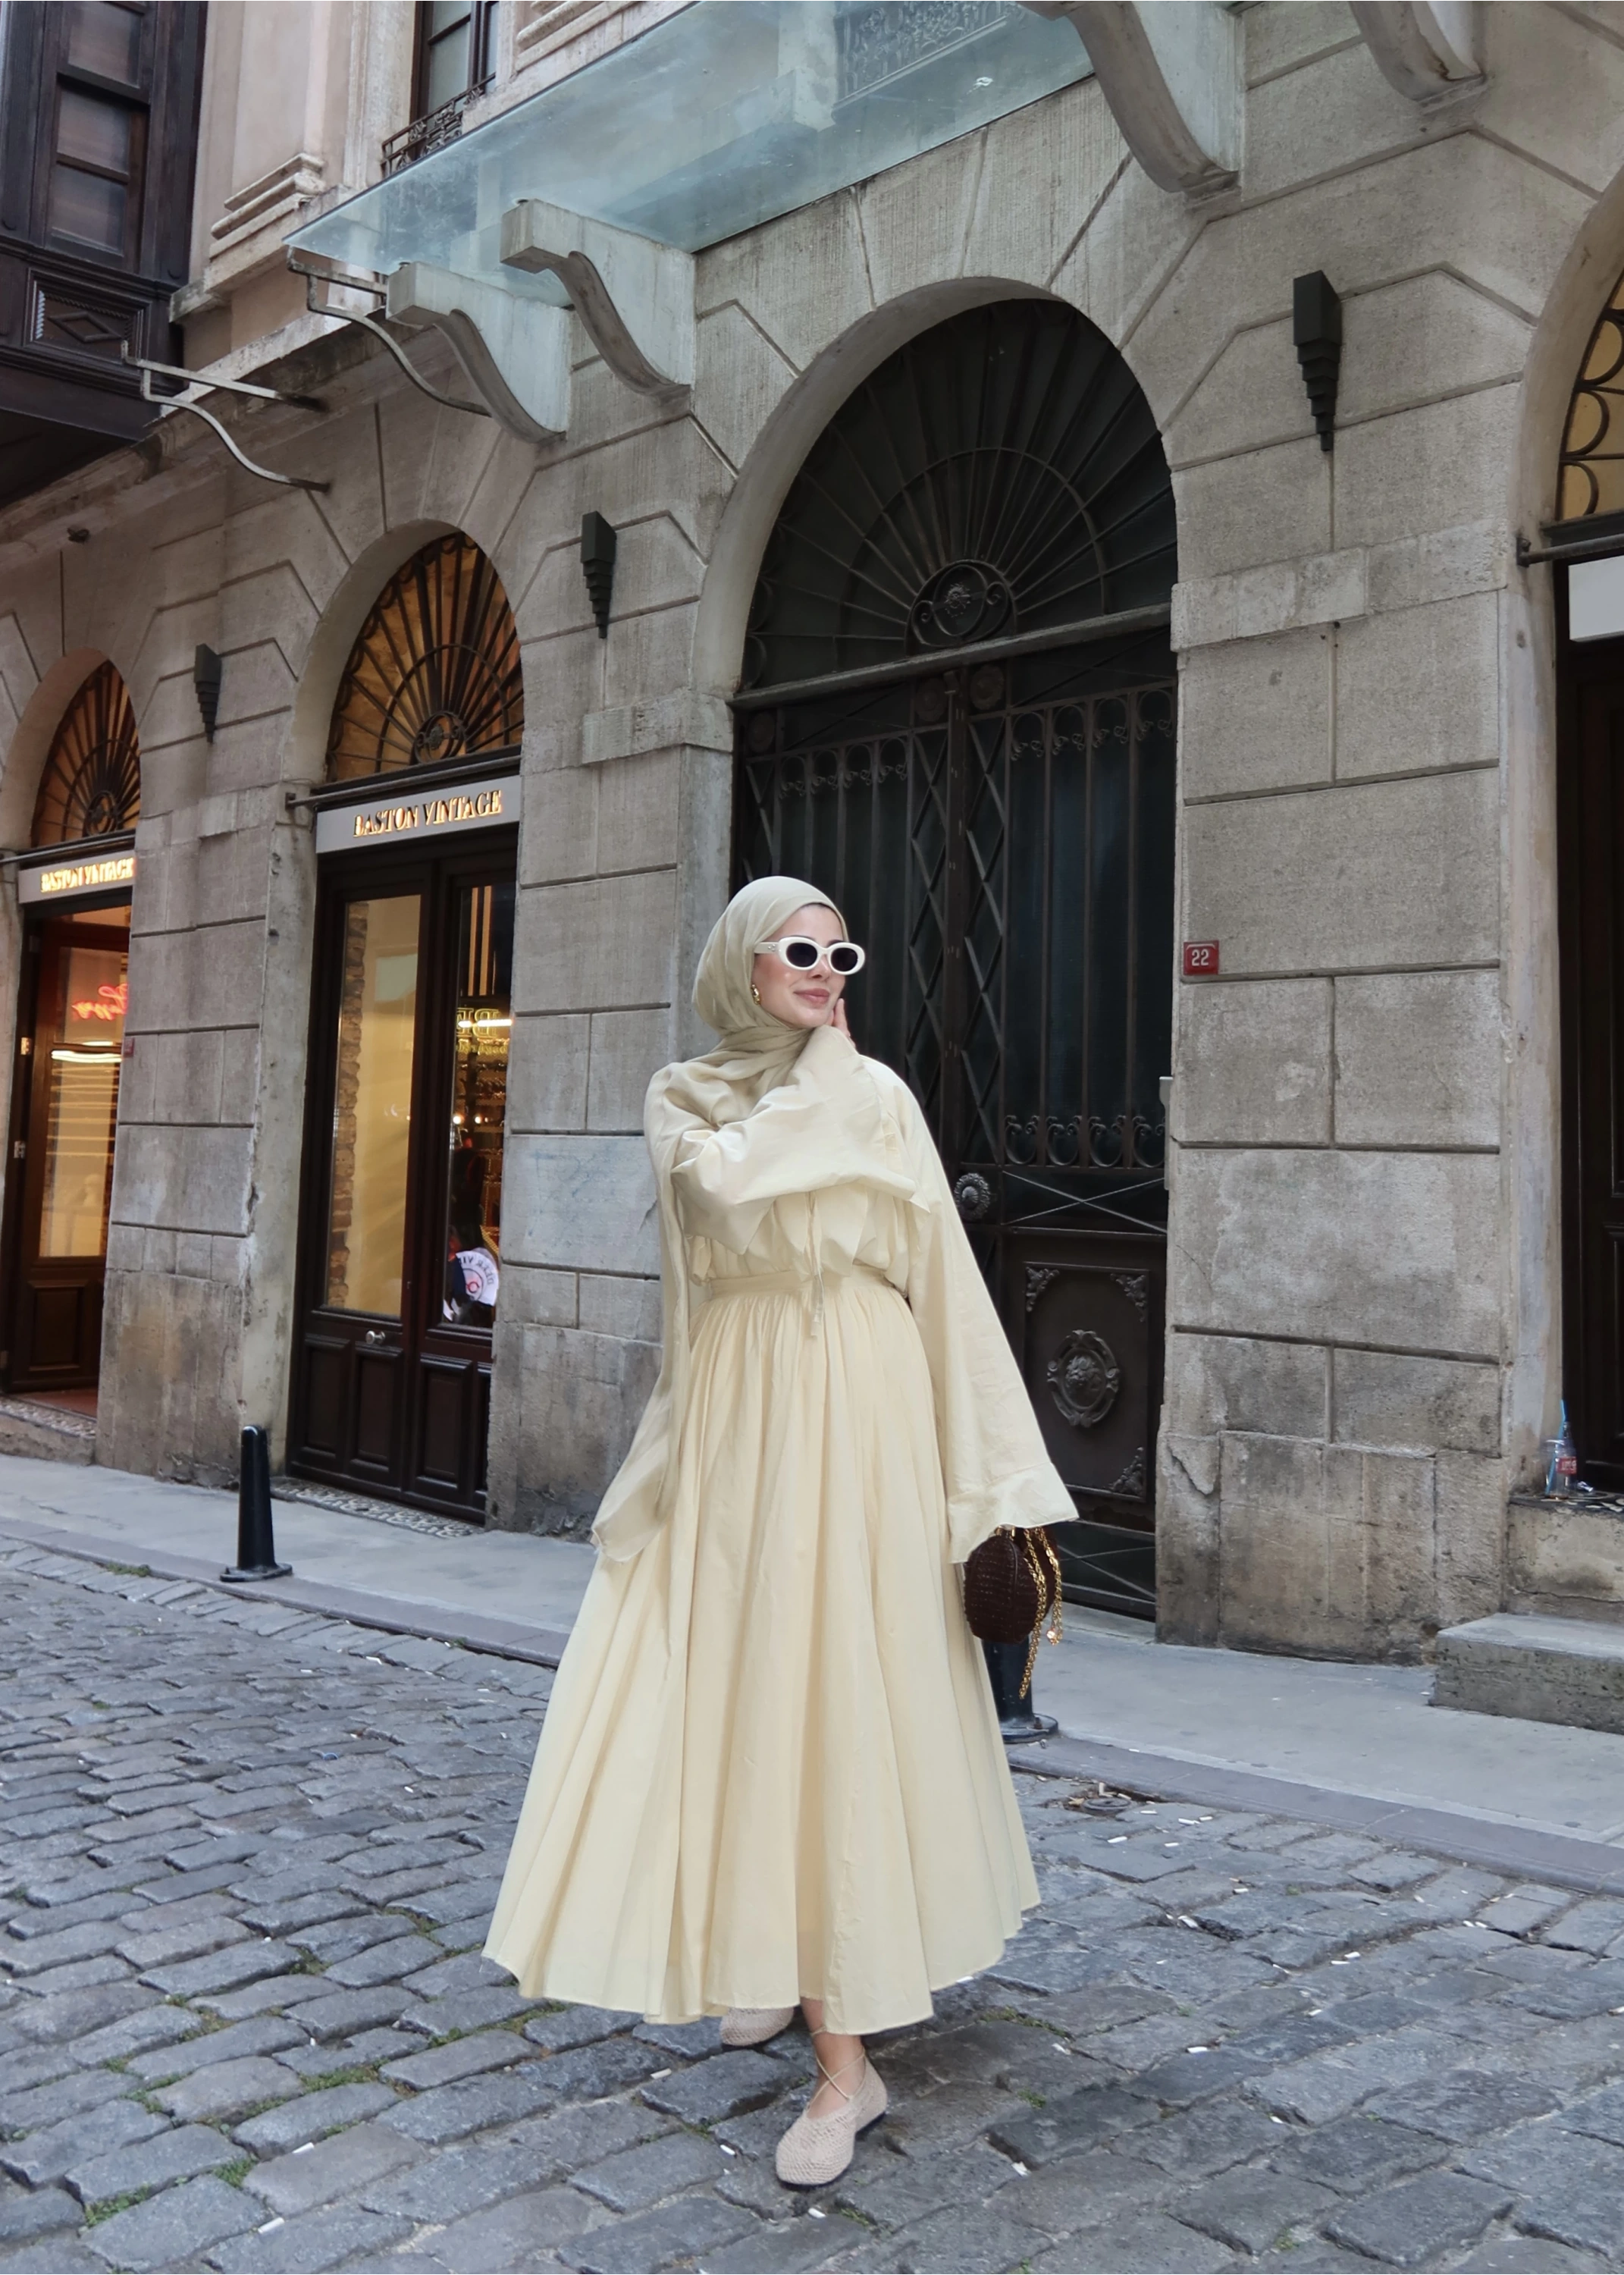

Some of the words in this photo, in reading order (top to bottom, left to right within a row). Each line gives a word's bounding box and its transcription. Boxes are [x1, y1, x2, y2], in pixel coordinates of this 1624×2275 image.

[353, 805, 418, 837] BASTON
[422, 789, 502, 825] VINTAGE
[1191, 949, 1209, 966] 22
